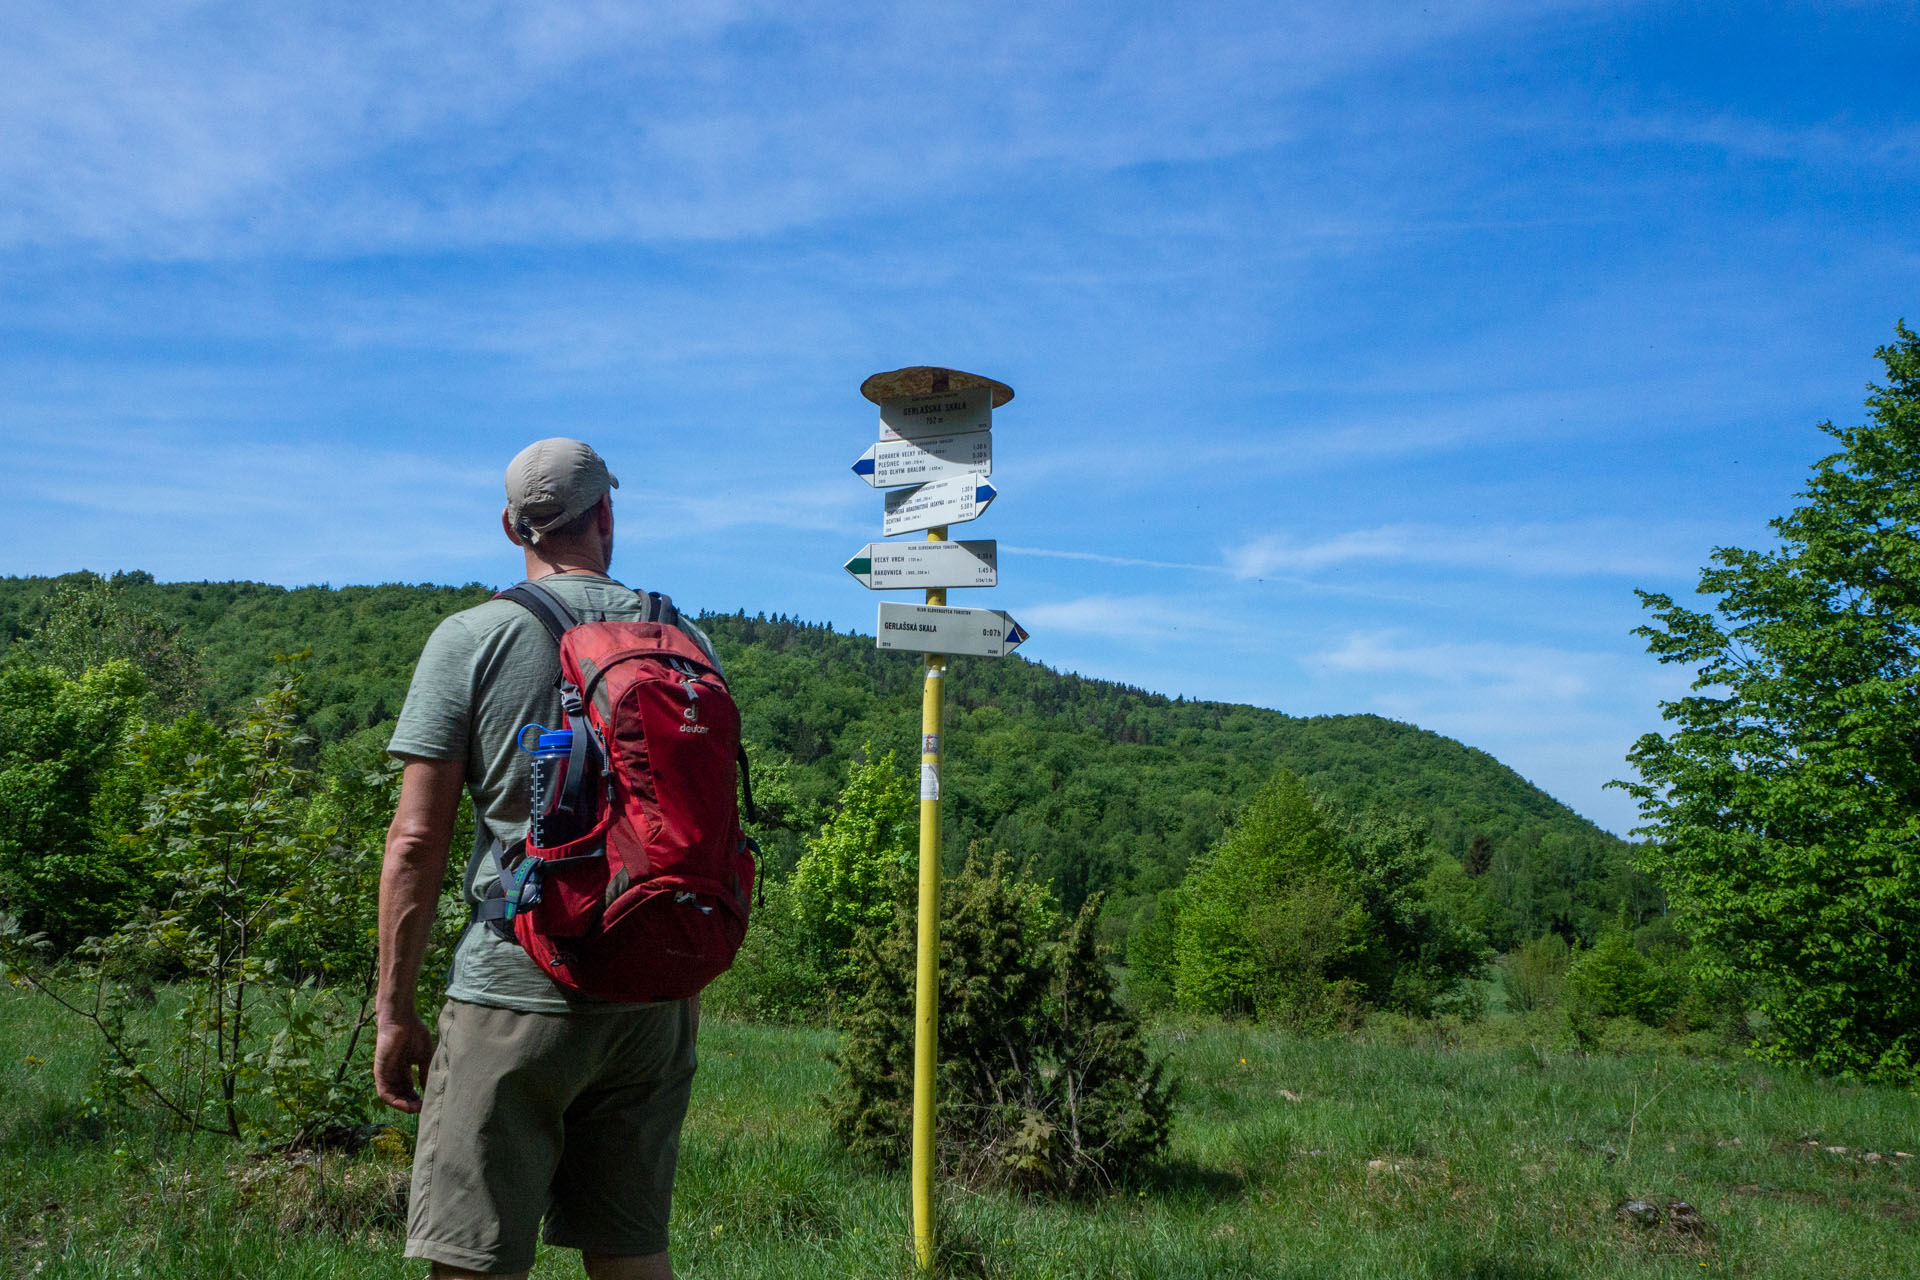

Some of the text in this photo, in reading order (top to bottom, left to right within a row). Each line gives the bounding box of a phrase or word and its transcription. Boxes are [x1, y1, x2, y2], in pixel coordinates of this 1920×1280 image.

[884, 621, 937, 633] GERLAŠSKÁ SKALA
[680, 723, 710, 734] deuter
